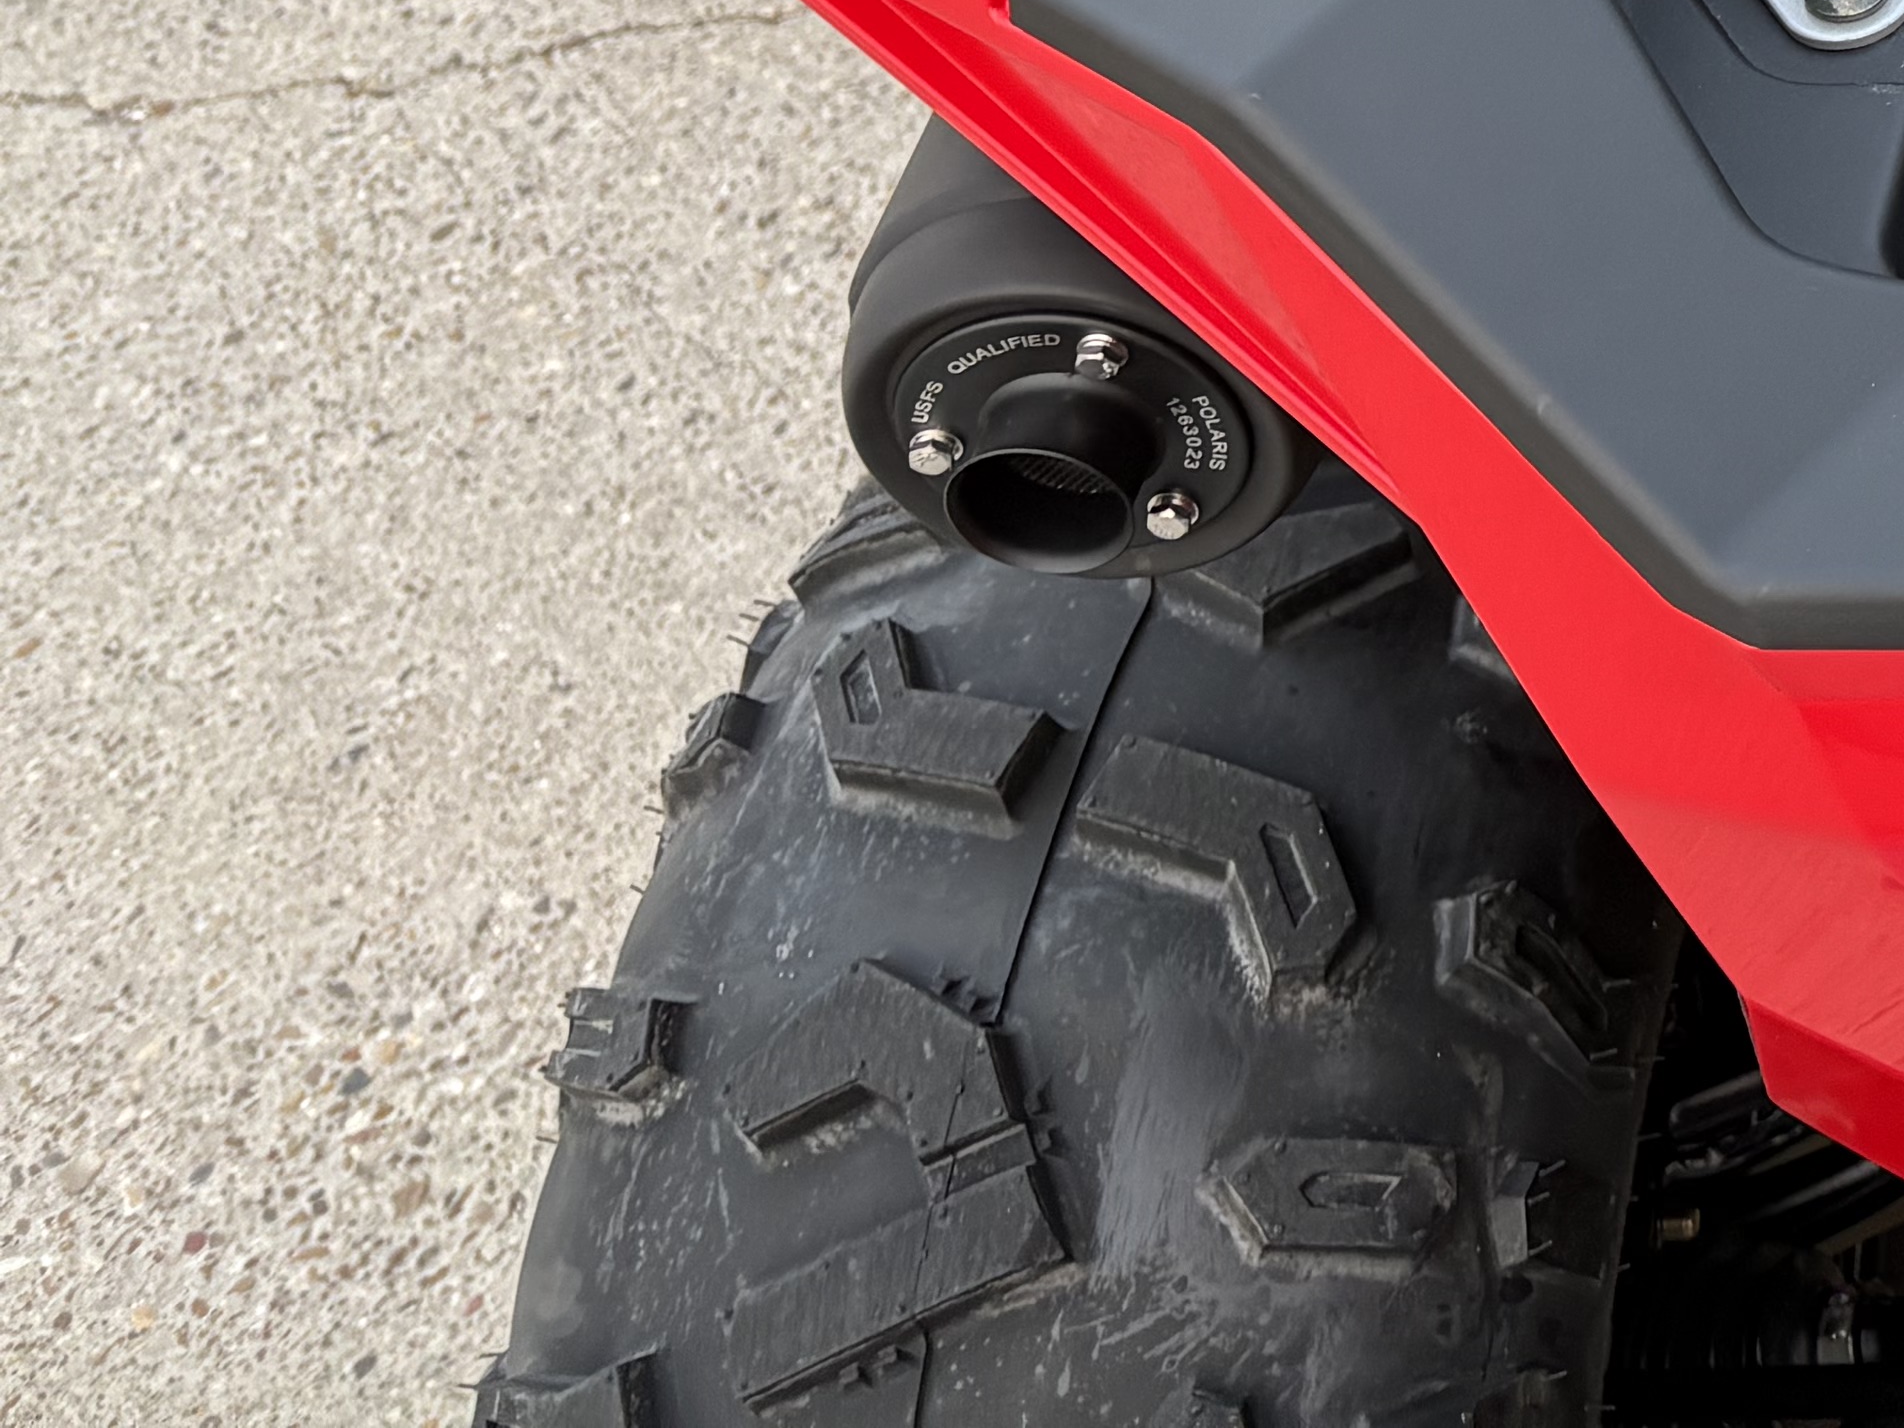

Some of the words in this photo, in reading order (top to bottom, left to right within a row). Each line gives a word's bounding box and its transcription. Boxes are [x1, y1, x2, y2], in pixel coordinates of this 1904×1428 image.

[911, 380, 943, 424] USFS
[947, 333, 1061, 375] QUALIFIED
[1166, 397, 1203, 470] 1263023
[1191, 395, 1228, 471] POLARIS
